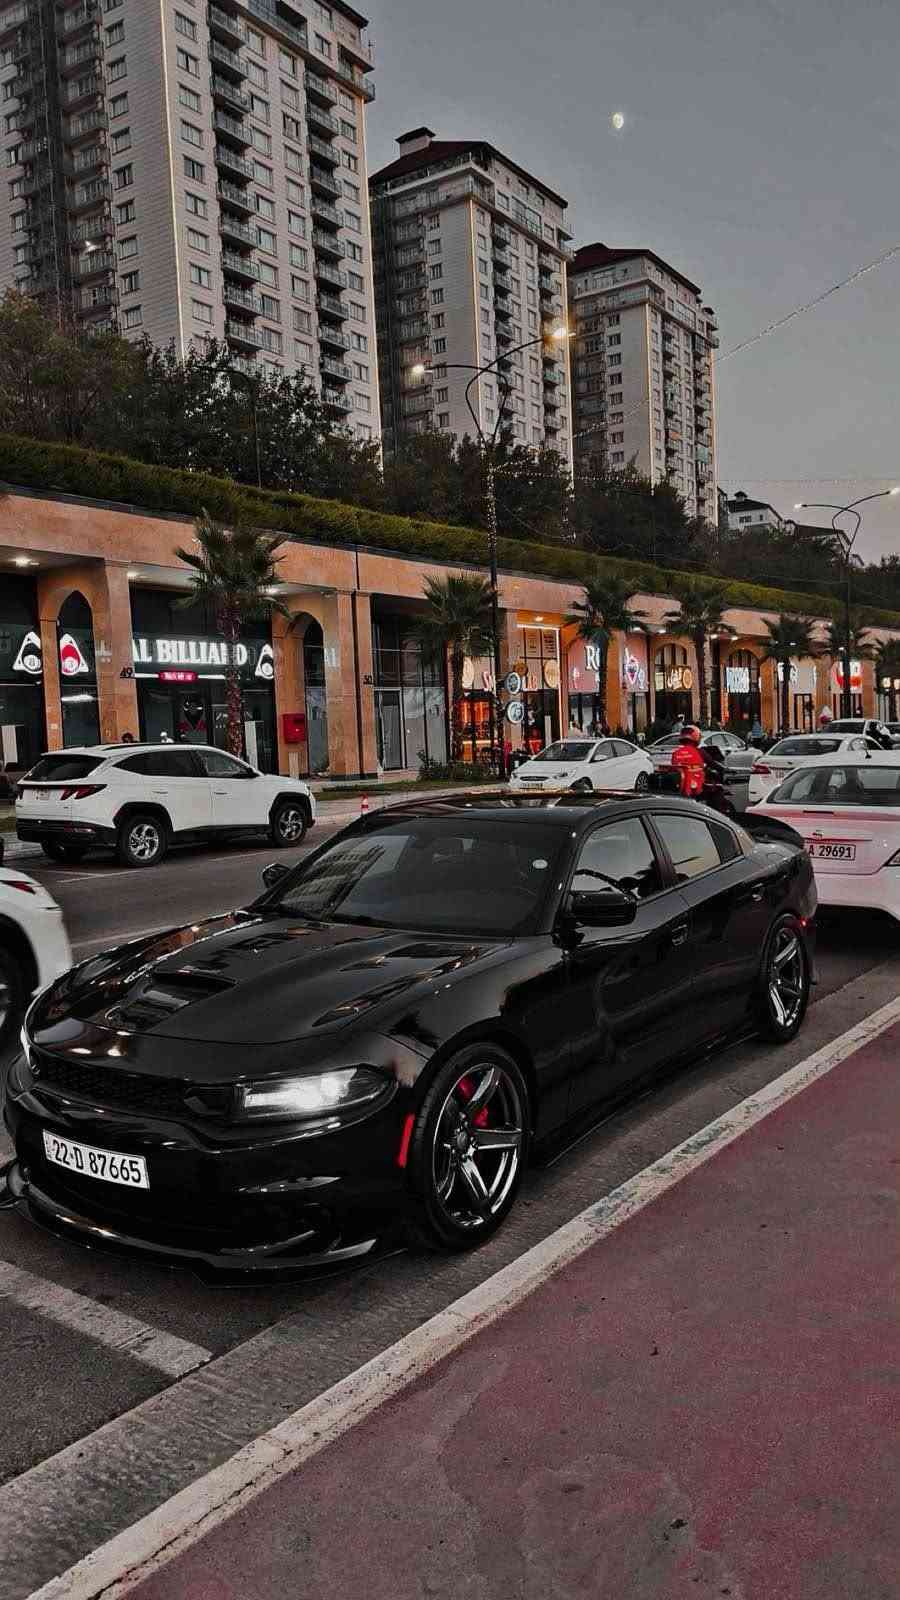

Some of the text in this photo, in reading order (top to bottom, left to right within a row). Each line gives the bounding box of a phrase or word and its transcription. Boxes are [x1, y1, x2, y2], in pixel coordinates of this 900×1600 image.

[120, 666, 133, 677] 49
[818, 845, 852, 858] 29691
[53, 1139, 84, 1170] 22-D
[89, 1151, 141, 1183] 87665
